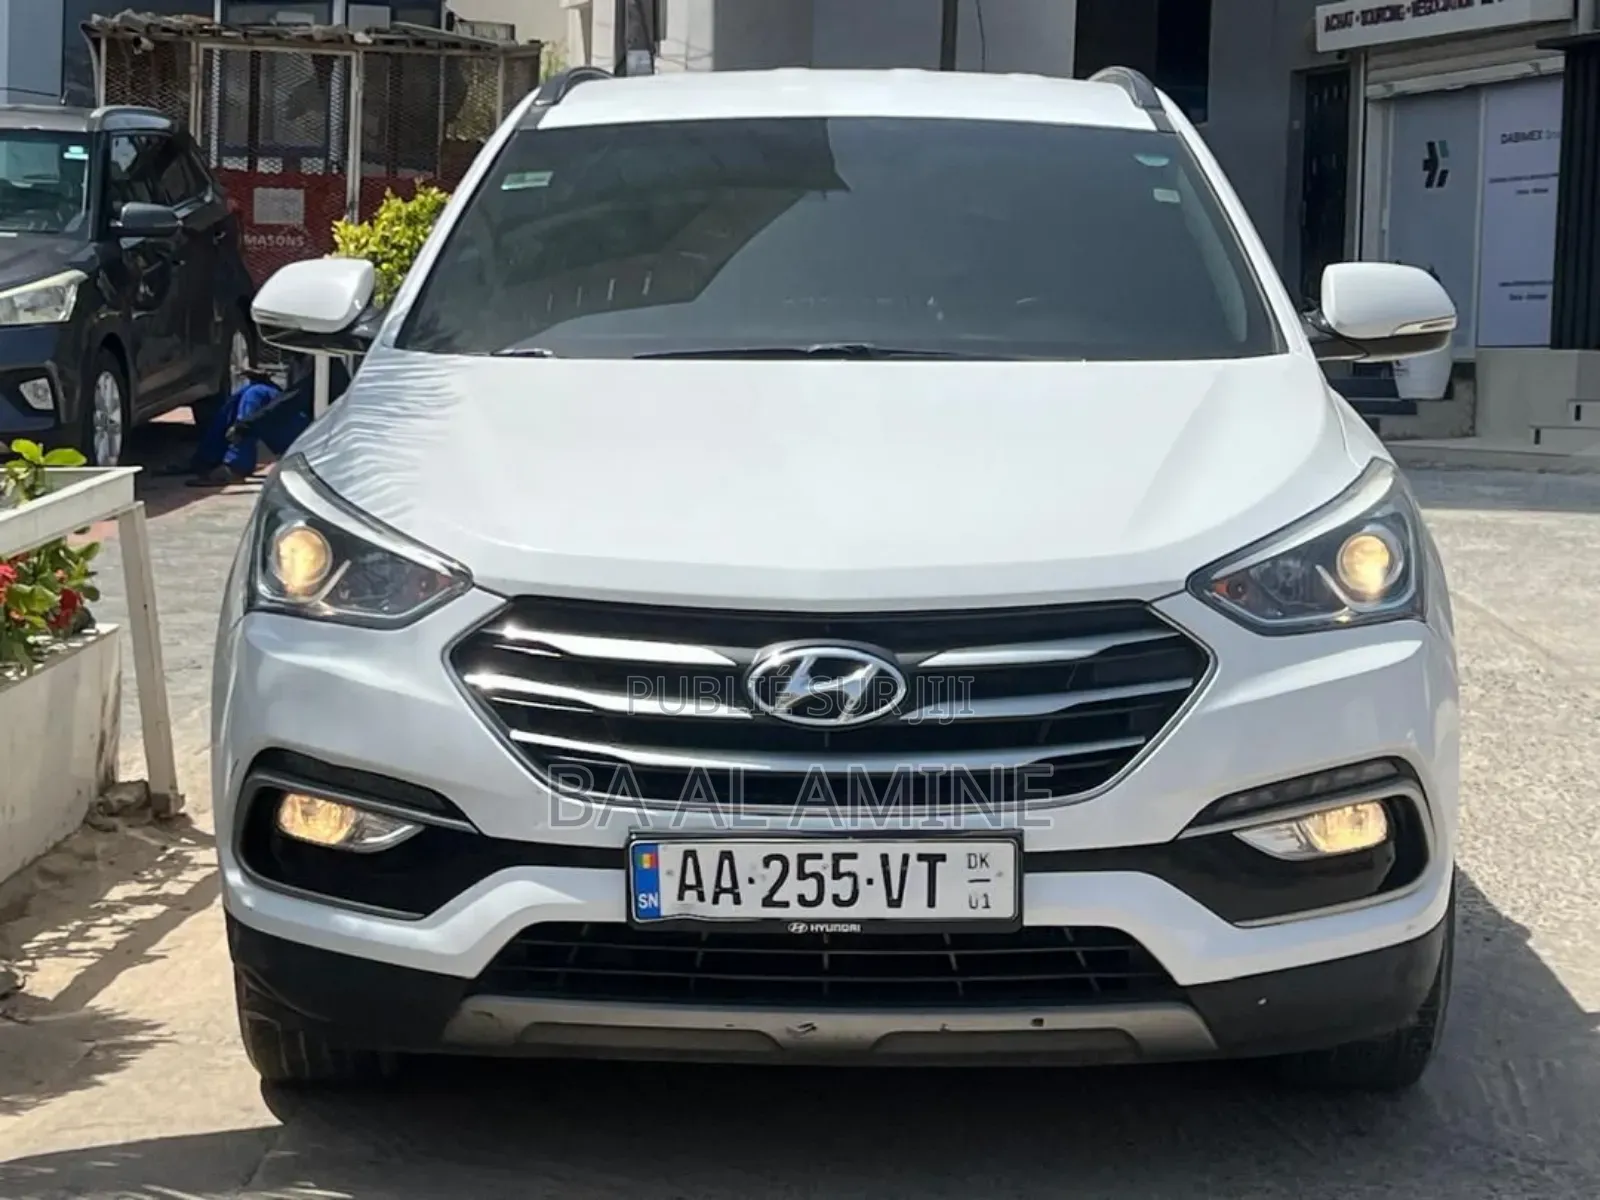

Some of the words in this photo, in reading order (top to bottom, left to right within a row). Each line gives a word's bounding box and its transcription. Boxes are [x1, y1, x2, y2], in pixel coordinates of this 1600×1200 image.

[1324, 9, 1354, 33] ACHAT
[966, 852, 990, 869] DK
[637, 892, 659, 908] SN
[810, 923, 861, 933] HYUNDAI
